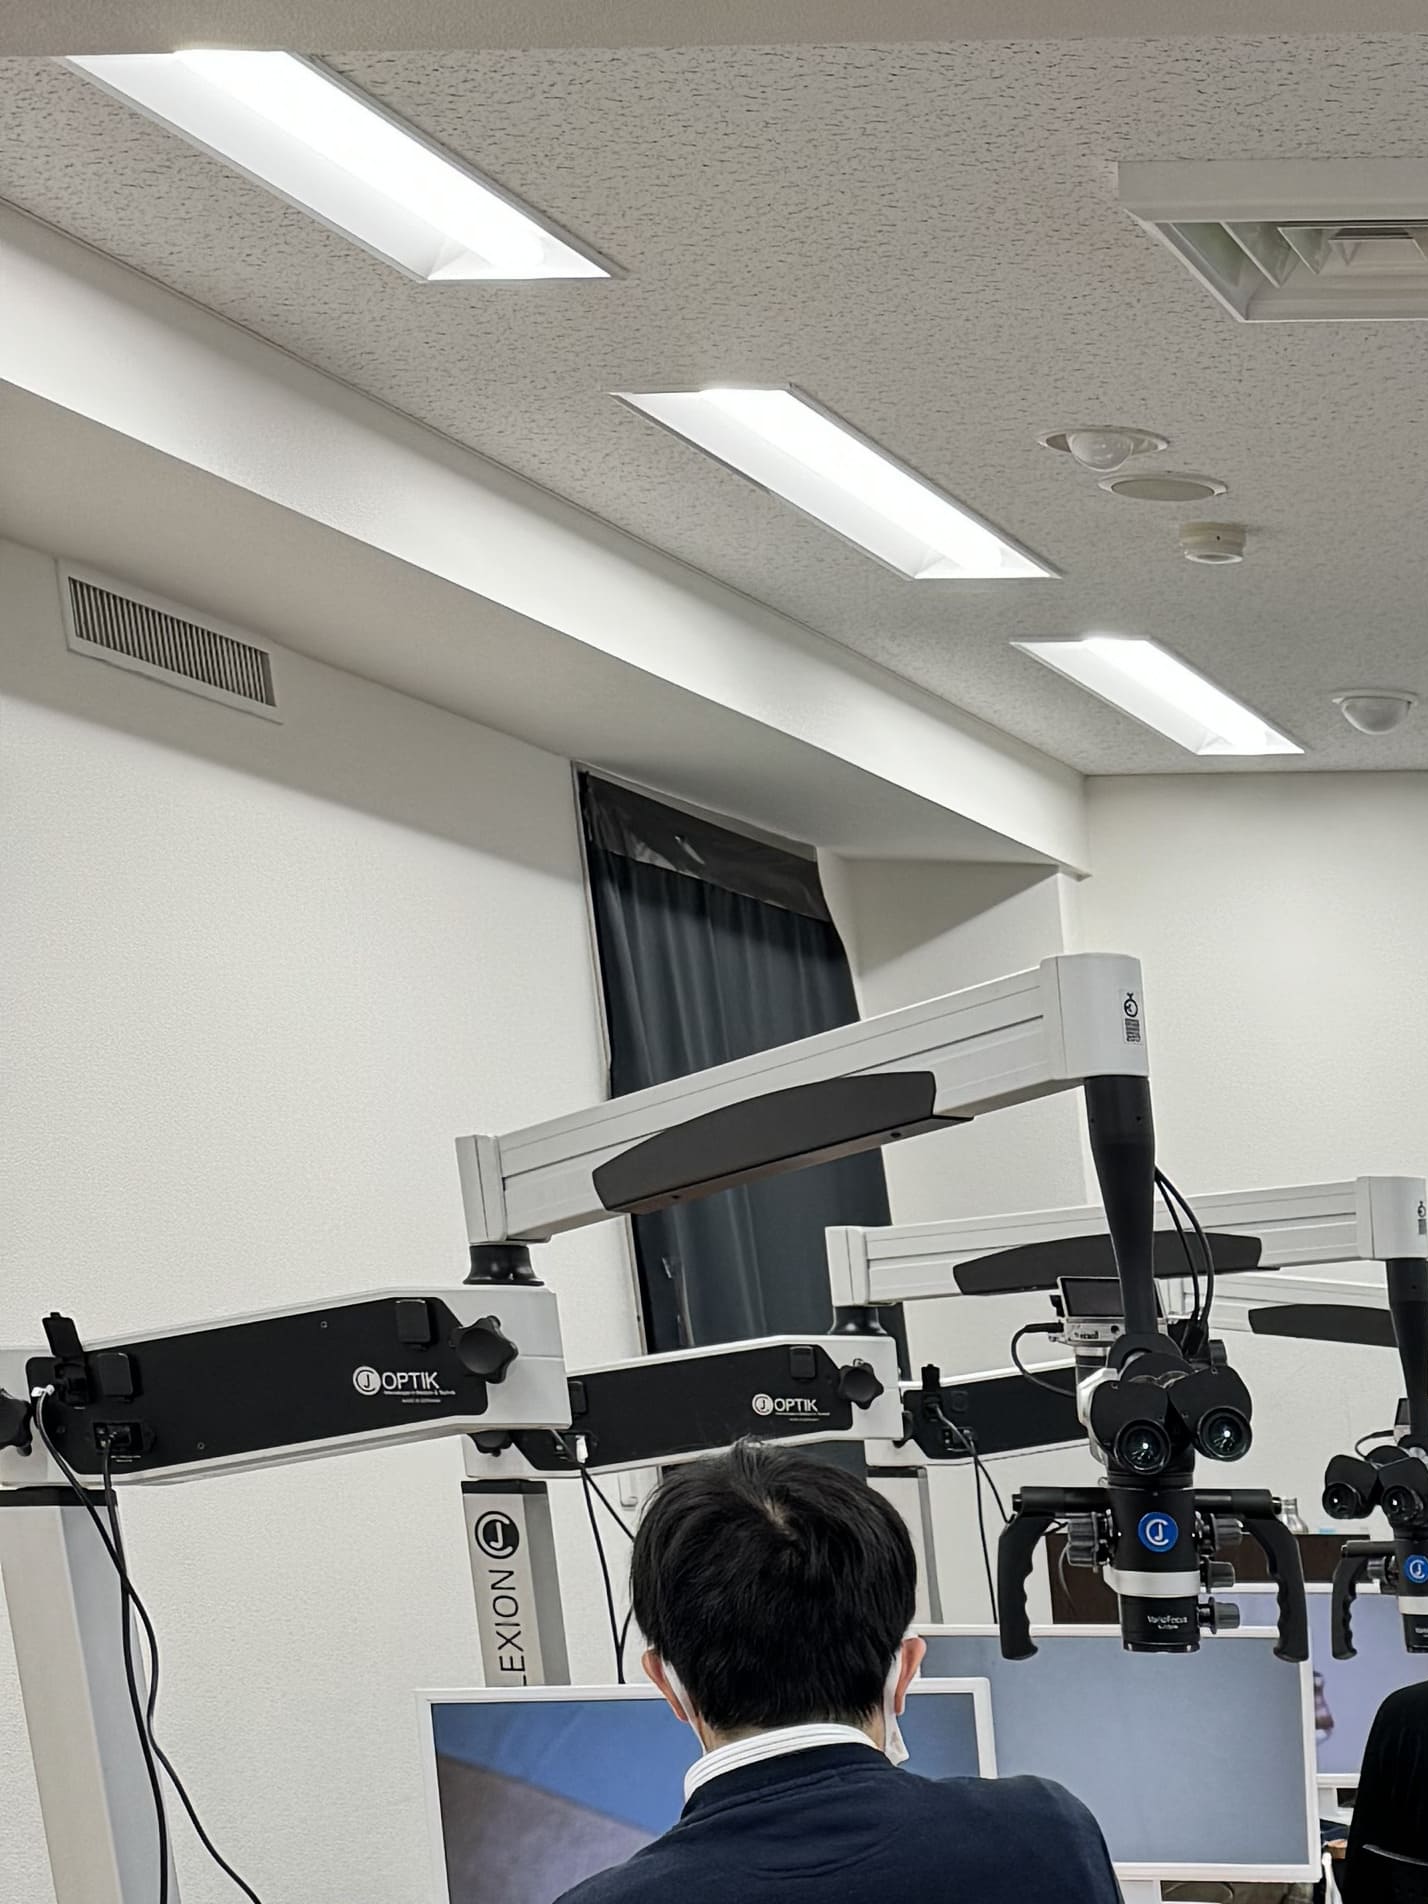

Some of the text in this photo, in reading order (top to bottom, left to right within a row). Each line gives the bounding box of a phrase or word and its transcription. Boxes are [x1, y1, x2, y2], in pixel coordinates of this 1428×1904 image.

[382, 1371, 440, 1390] OPTIK
[774, 1398, 818, 1412] OPTIK
[488, 1569, 528, 1687] EXION
